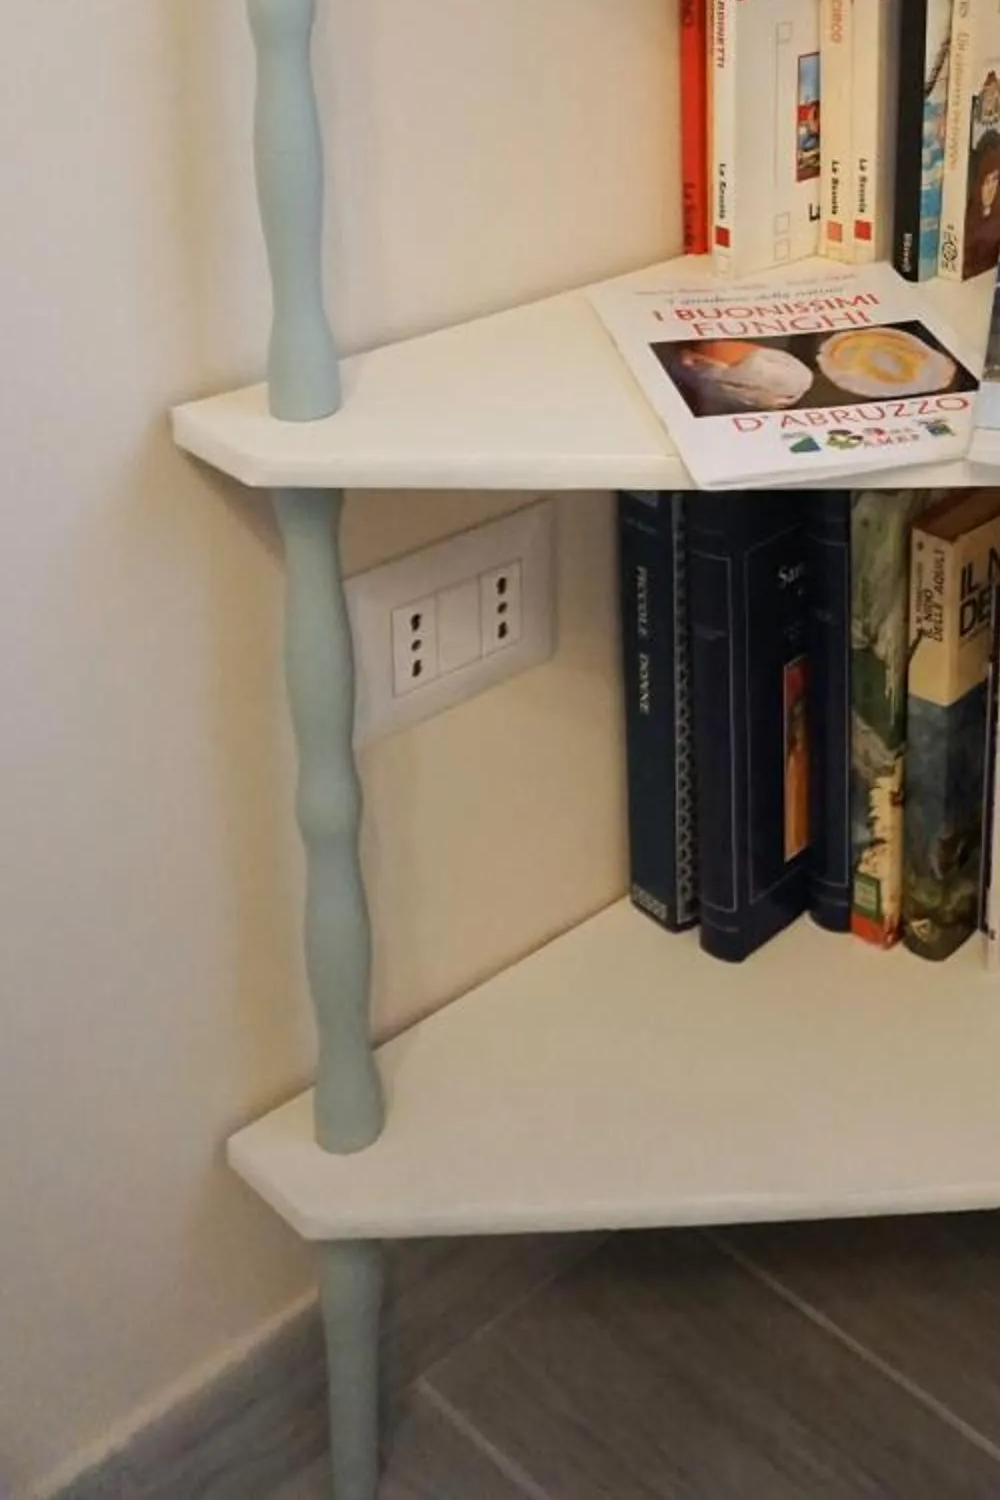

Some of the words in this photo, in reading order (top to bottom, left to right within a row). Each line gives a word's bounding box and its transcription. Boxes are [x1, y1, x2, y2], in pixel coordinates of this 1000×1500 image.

[651, 309, 664, 322] I
[674, 292, 880, 321] BUONISSIMI
[691, 310, 872, 337] FUNGHI
[732, 396, 970, 433] D'ABRUZZO
[960, 562, 979, 602] IL
[638, 653, 650, 716] DONNE
